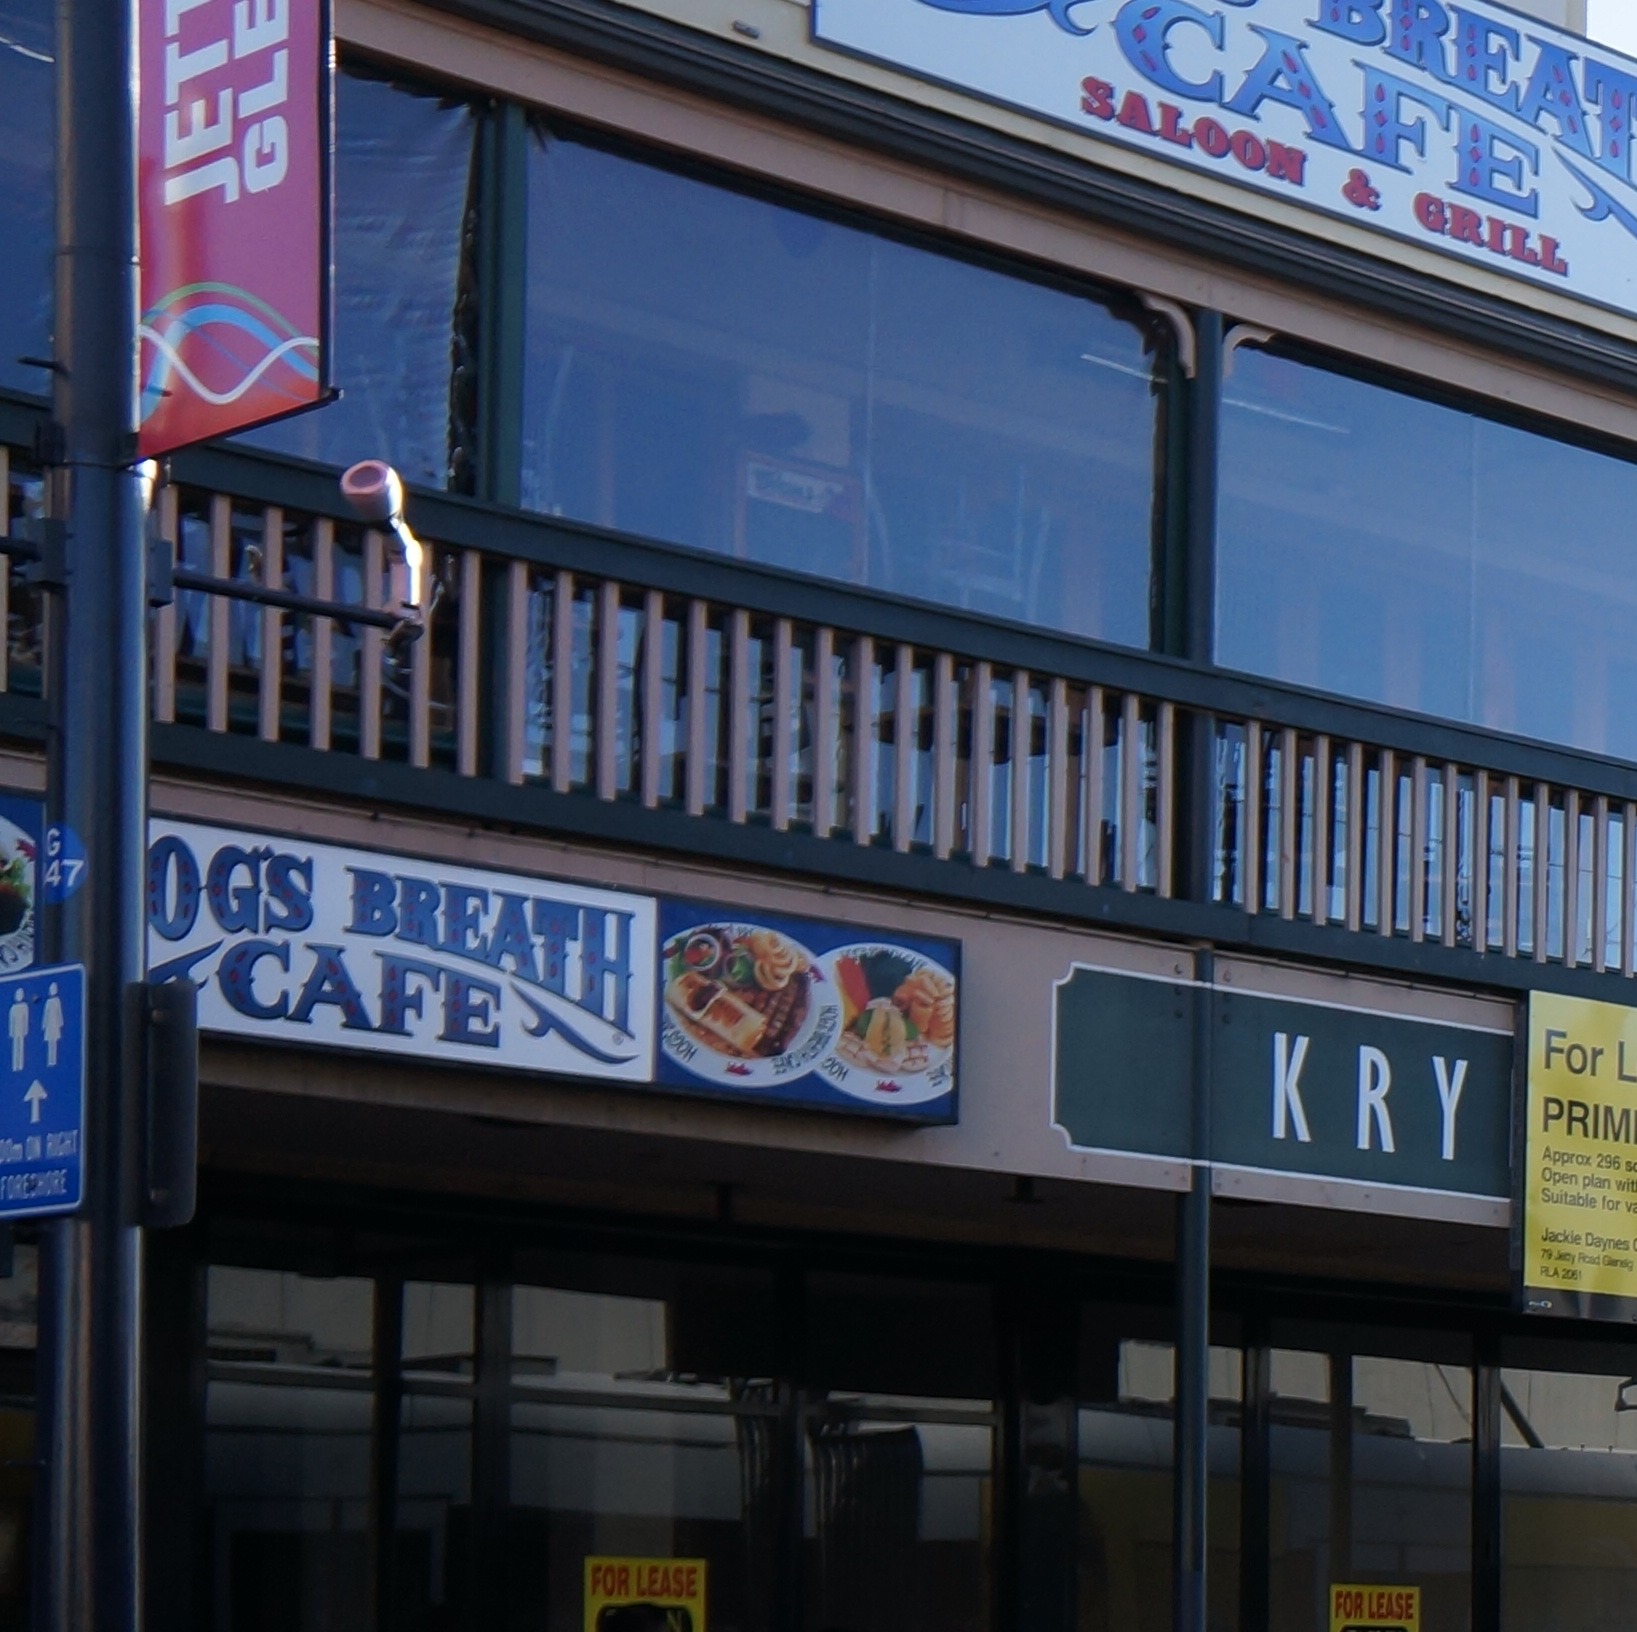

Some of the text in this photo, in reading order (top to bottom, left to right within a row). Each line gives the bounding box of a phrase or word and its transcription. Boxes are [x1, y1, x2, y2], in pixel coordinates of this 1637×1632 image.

[1108, 0, 1540, 219] CAFE
[1081, 76, 1569, 278] SALOON & GRILL
[46, 828, 61, 856] G
[42, 859, 84, 890] 47
[343, 864, 635, 1040] BREATH
[217, 939, 501, 1048] CAFE
[1543, 1028, 1605, 1078] For
[1542, 1146, 1593, 1168] Approx
[1597, 1153, 1621, 1170] 296
[1541, 1166, 1578, 1188] Open
[1582, 1173, 1611, 1192] plan
[1541, 1187, 1598, 1209] Suitable
[1602, 1194, 1620, 1211] for
[1541, 1227, 1582, 1246] Jackie
[1585, 1231, 1630, 1253] Daynes
[1578, 1250, 1600, 1265] Road
[590, 1563, 698, 1598] FOR LEASE
[1334, 1590, 1414, 1620] FOR LEASE
